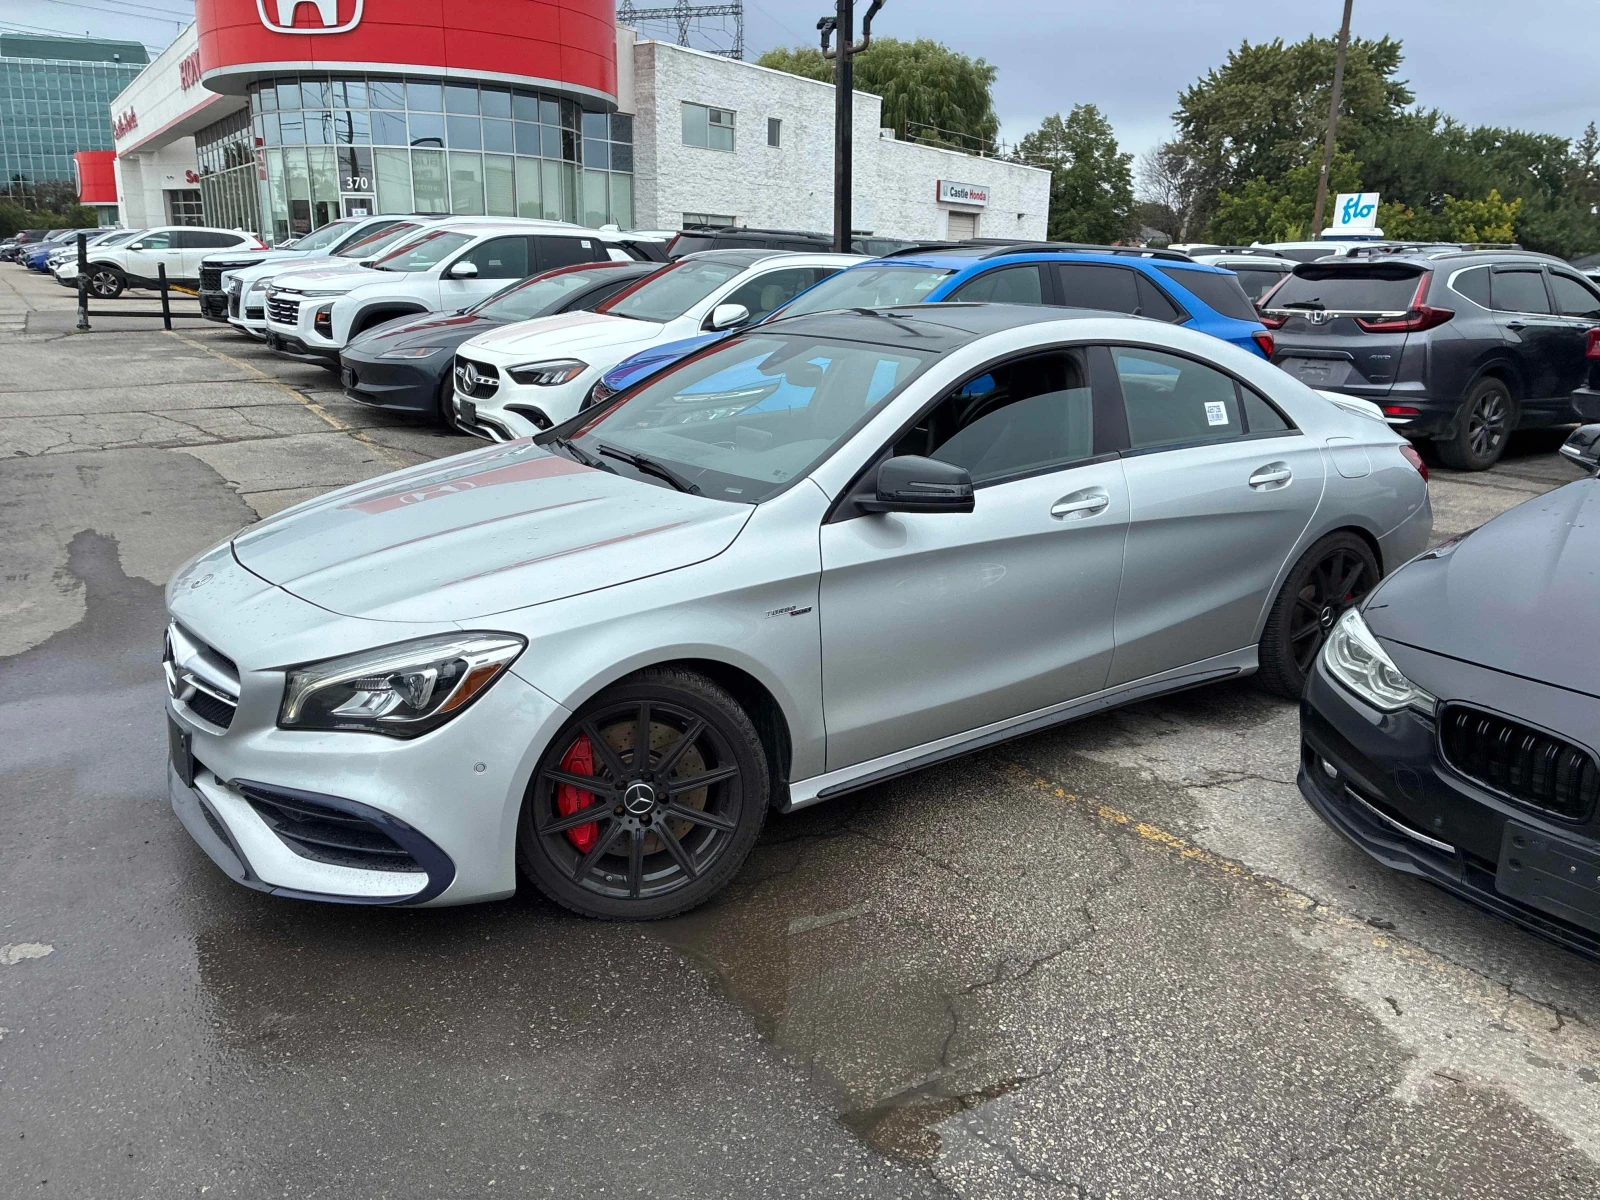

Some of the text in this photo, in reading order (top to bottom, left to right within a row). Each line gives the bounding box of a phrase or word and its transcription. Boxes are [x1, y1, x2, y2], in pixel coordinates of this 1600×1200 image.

[346, 176, 368, 189] 370
[949, 186, 987, 201] Castle Honda
[1342, 192, 1375, 225] flo
